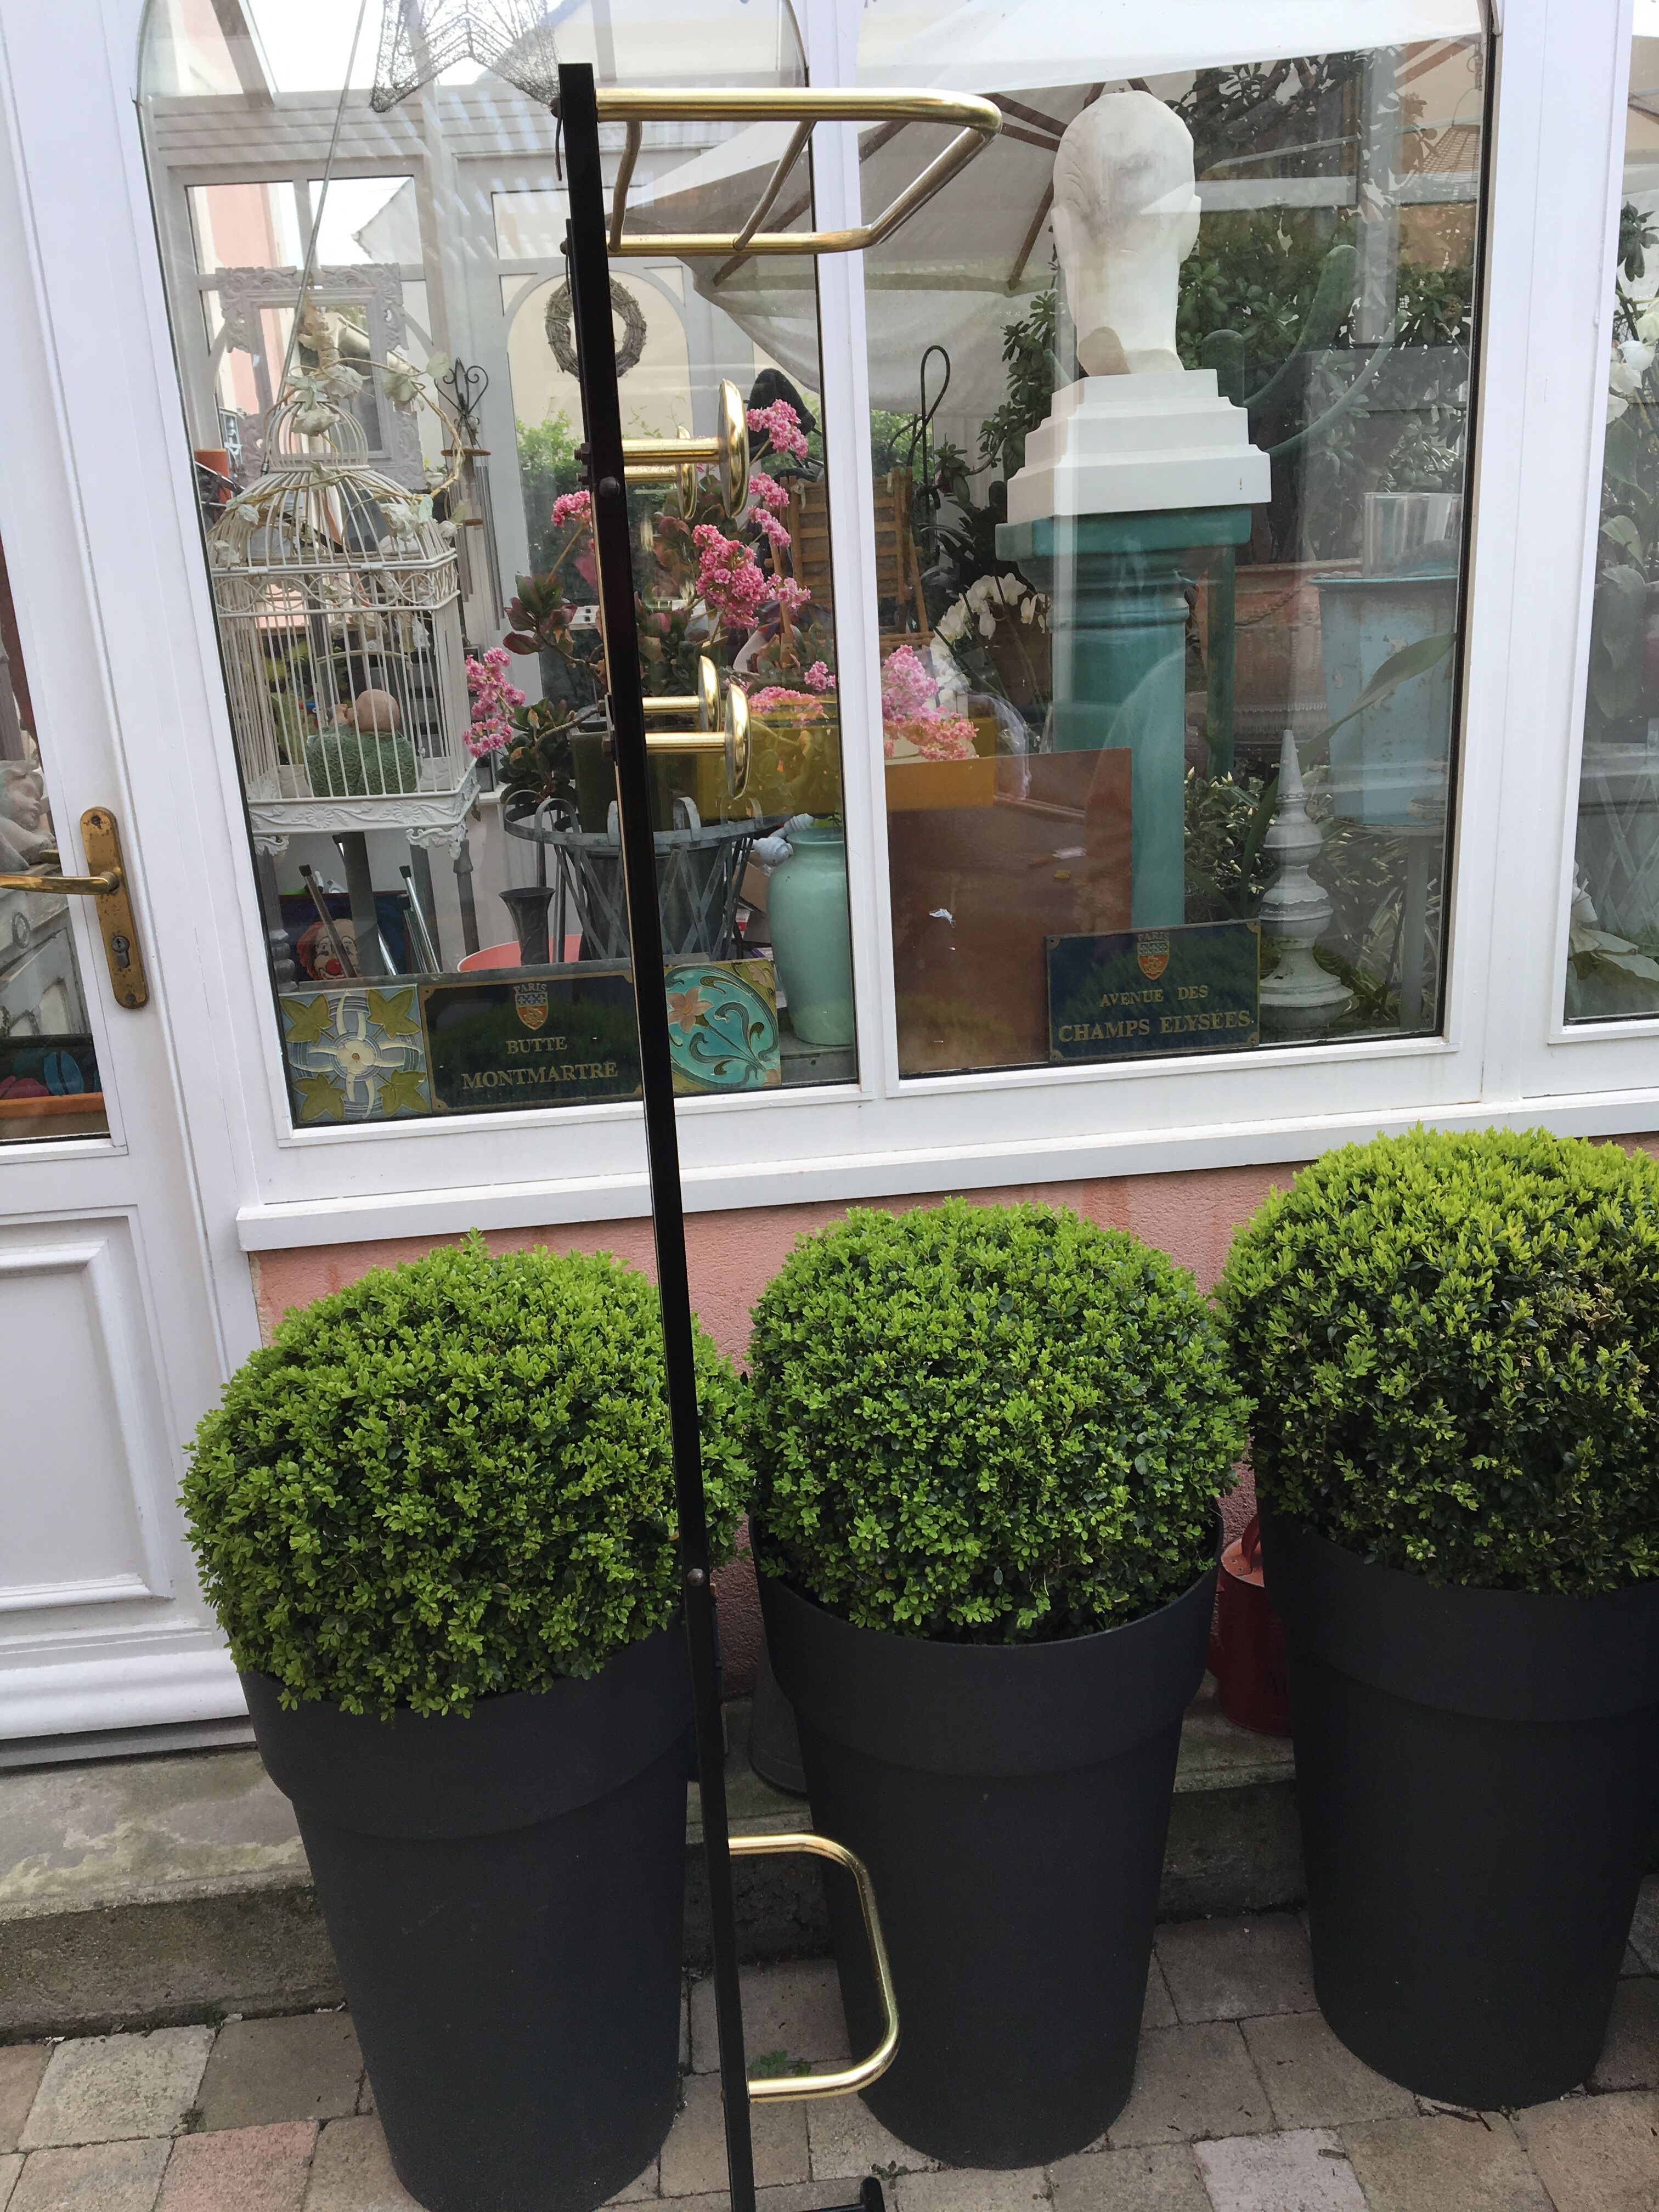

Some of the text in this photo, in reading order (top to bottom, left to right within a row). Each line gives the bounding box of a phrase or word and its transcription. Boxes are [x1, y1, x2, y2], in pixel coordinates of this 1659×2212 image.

[514, 983, 548, 993] PARIS
[1099, 985, 1207, 1007] AVENUE DES
[1059, 1009, 1251, 1042] CHAMPS ELYSÉES
[506, 1036, 567, 1054] BUTTE
[461, 1062, 618, 1090] MONTMARTRE
